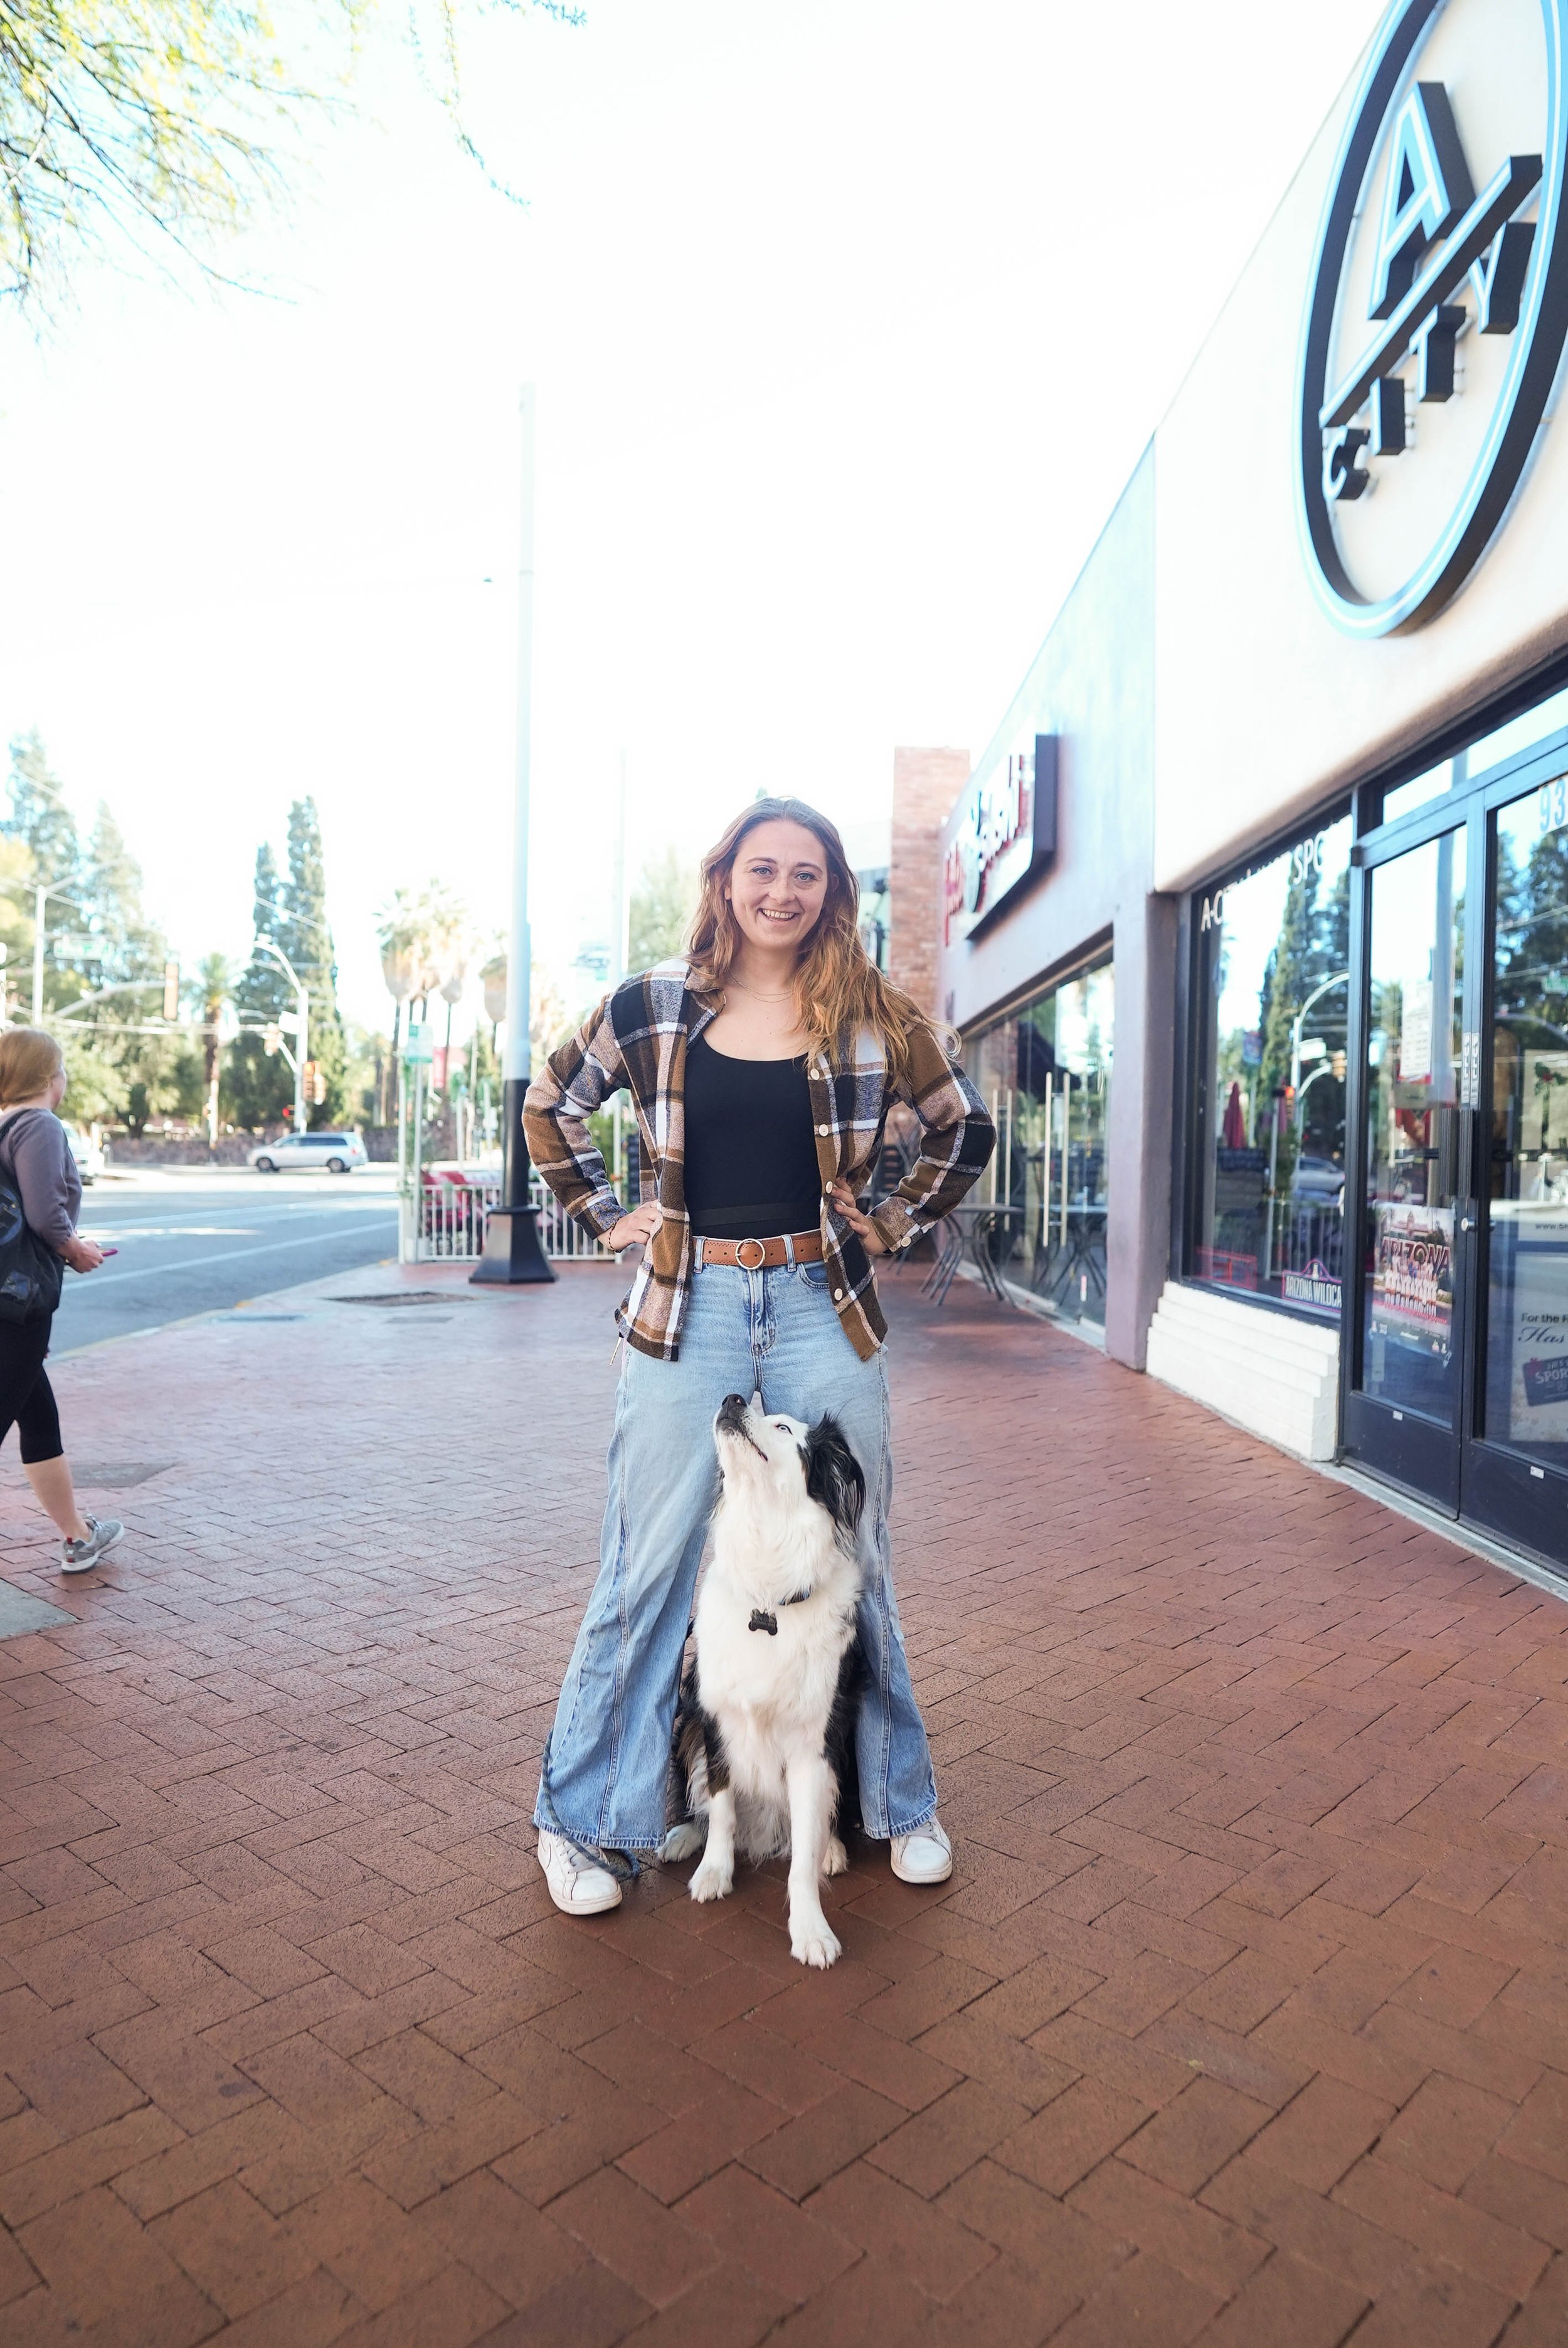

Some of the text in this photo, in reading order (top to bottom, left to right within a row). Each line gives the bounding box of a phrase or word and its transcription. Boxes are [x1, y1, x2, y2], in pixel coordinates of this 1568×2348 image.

[1368, 82, 1476, 320] A
[1322, 221, 1535, 501] CITY
[1380, 1236, 1452, 1282] ARIZONA
[1285, 1275, 1313, 1303] ARIZONA
[1521, 1312, 1539, 1322] For
[1541, 1314, 1560, 1324] the
